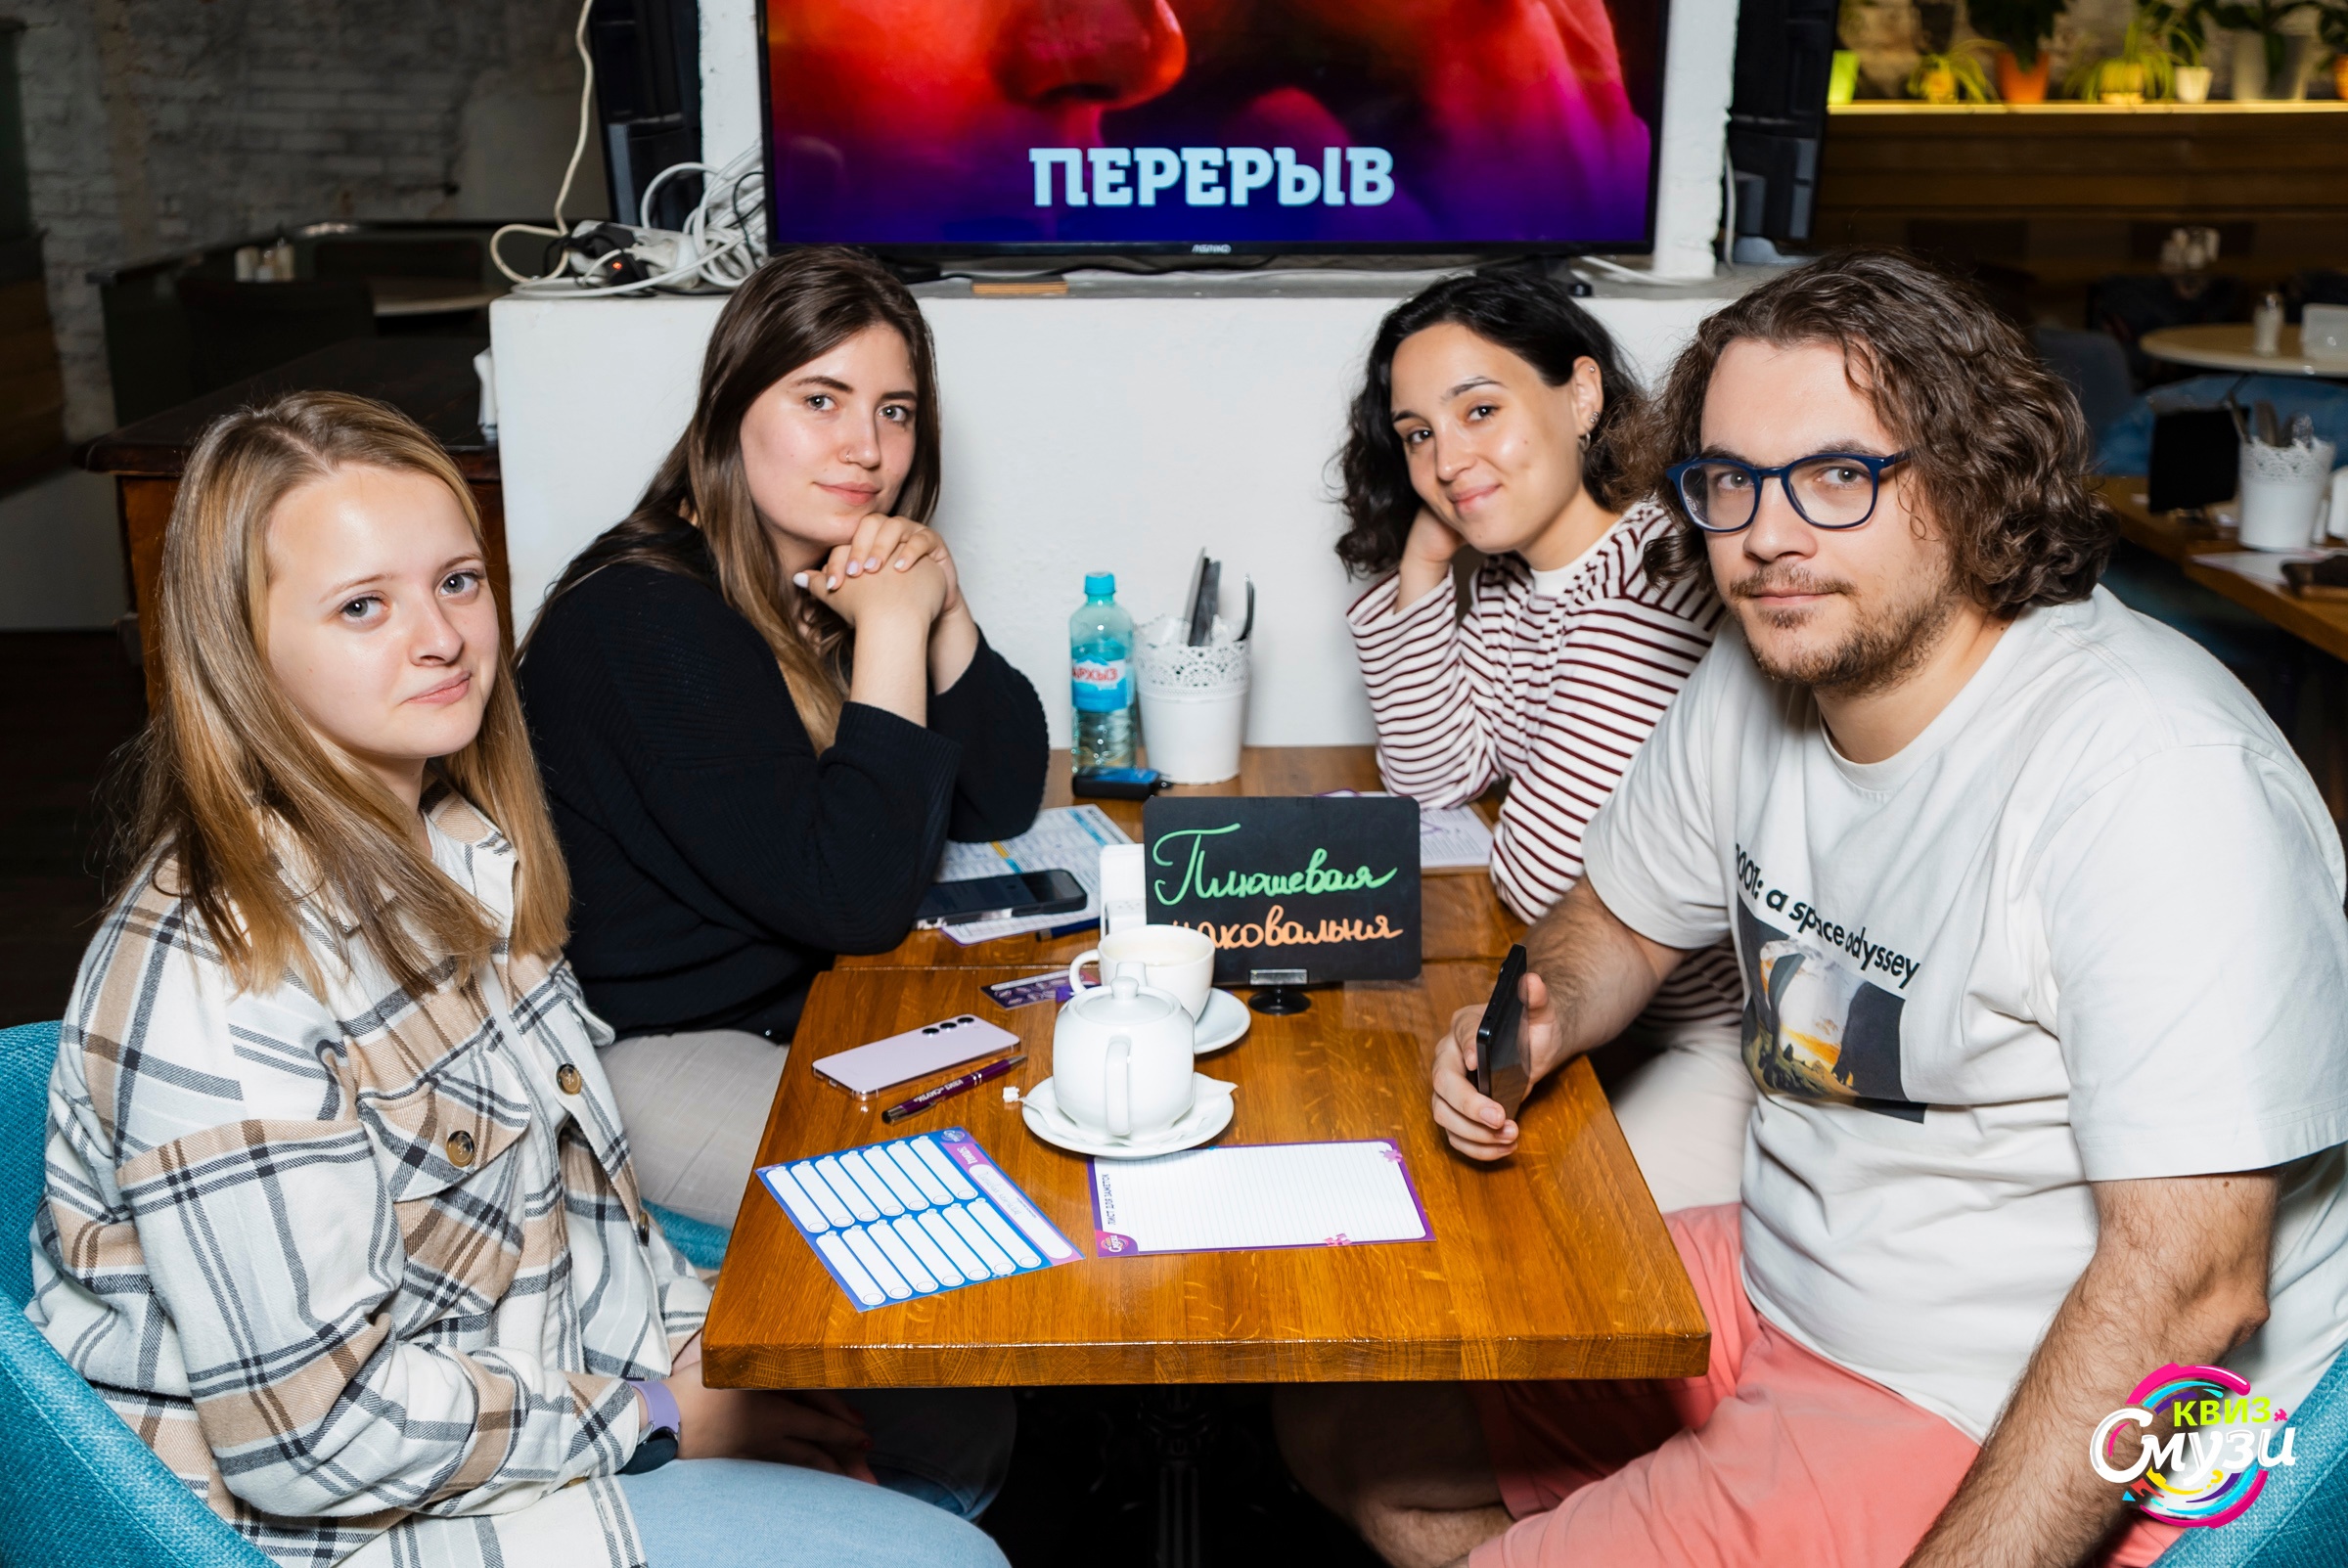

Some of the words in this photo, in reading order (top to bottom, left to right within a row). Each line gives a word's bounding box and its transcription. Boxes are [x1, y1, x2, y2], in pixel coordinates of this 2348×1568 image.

[1028, 147, 1395, 207] ПЕРЕРЫВ
[1152, 823, 1398, 906] Плюшевая
[1172, 904, 1404, 950] аковальня
[1736, 842, 1764, 900] 001:
[1766, 889, 1789, 913] a
[1845, 927, 1920, 989] odyssey
